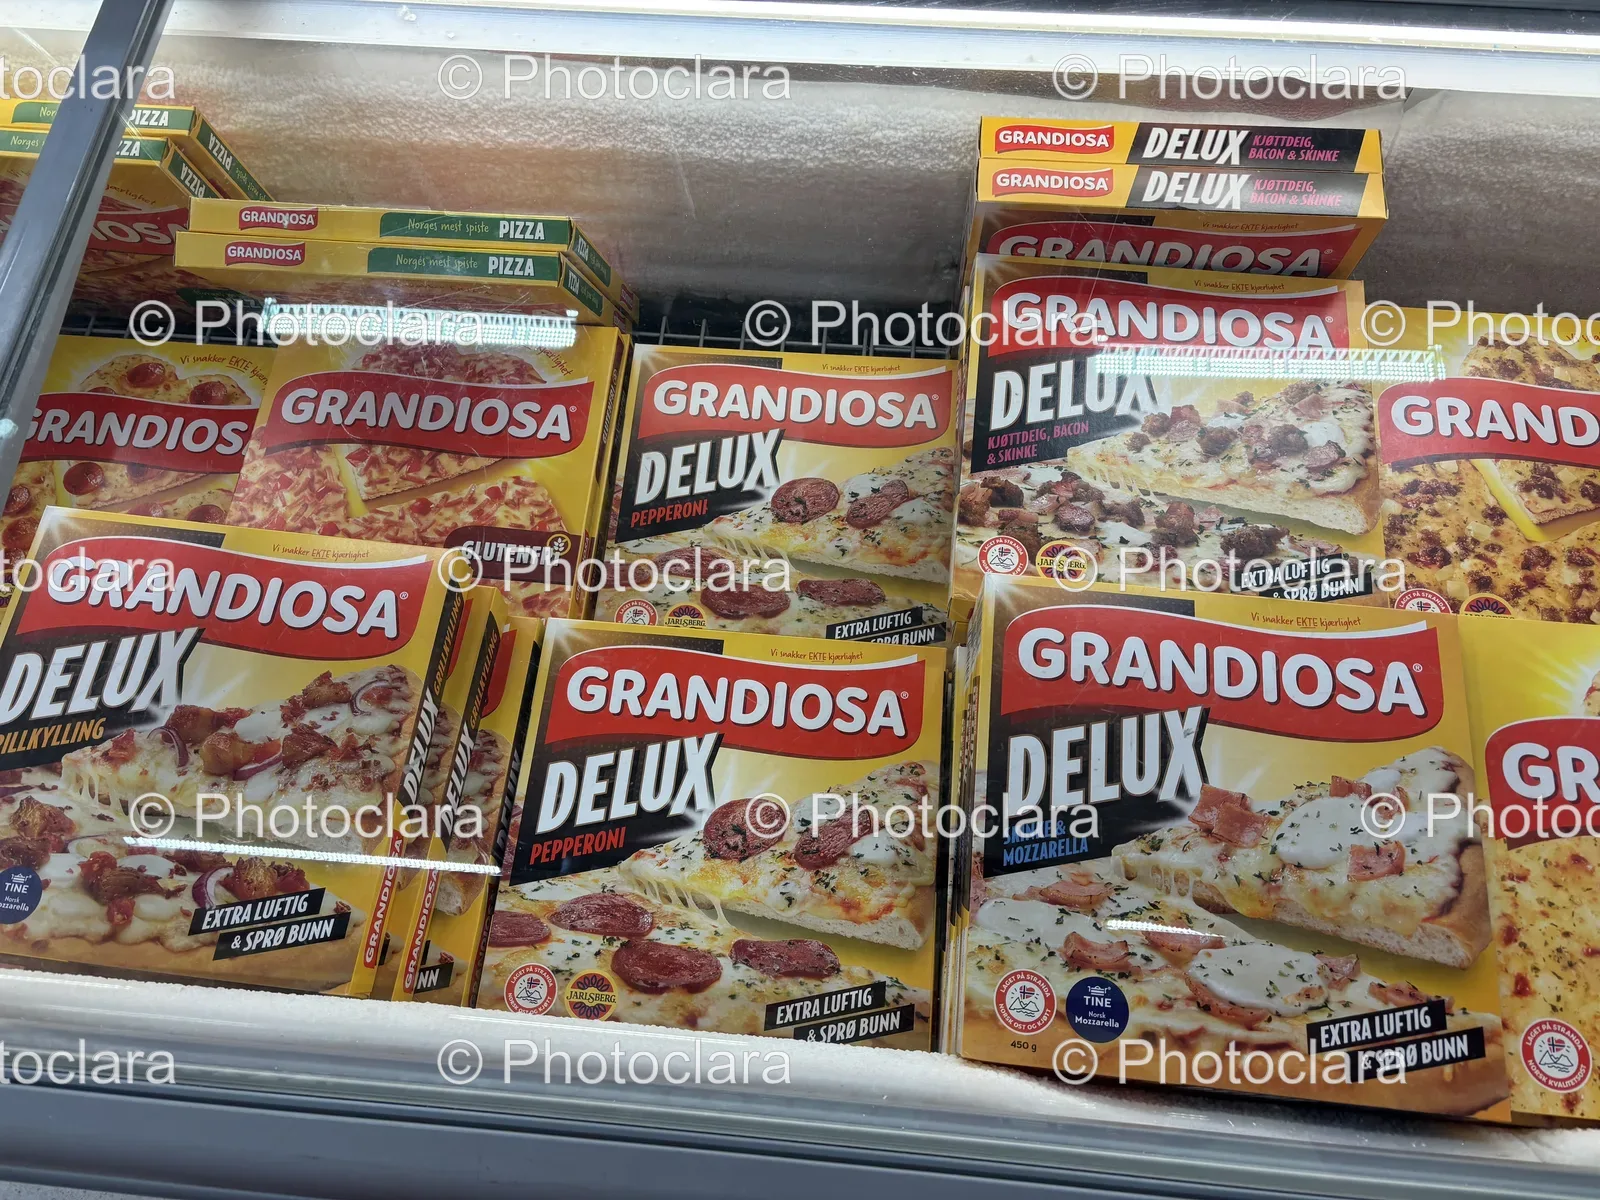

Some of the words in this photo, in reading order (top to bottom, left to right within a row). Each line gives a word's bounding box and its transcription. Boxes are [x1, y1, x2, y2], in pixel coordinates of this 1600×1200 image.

[10, 135, 39, 150] Norges
[208, 132, 233, 171] PIZZA
[998, 129, 1110, 148] GRANDIOSA
[1142, 127, 1250, 166] DELUX
[1252, 135, 1315, 149] KJØTTDEIG,
[1248, 148, 1286, 160] BACON
[1287, 150, 1297, 160] &
[1299, 149, 1340, 162] SKINKE
[996, 172, 1108, 192] GRANDIOSA
[1141, 170, 1251, 209] DELUX
[1254, 179, 1317, 194] KJØTTDEIG,
[1250, 192, 1288, 205] BACON
[1288, 194, 1298, 205] &
[1300, 193, 1343, 207] SKINKE
[241, 210, 316, 226] GRANDIOSA
[408, 218, 438, 232] Norges
[440, 219, 462, 231] mest
[466, 221, 489, 236] spiste
[499, 220, 545, 241] PIZZA
[1240, 222, 1260, 231] EKTE
[227, 246, 302, 261] GRANDIOSA
[395, 254, 426, 268] Norges
[429, 256, 451, 268] mest
[454, 259, 478, 271] spiste
[488, 256, 535, 278] PIZZA
[998, 235, 1322, 277] GRANDIOSA
[1193, 279, 1202, 288] Vi
[1202, 281, 1230, 290] snakker
[1231, 282, 1250, 292] EKTE
[1250, 282, 1285, 293] kjærlighet
[1003, 291, 1335, 350] GRANDIOSA
[180, 355, 190, 365] Vi
[192, 353, 226, 364] snakker
[228, 355, 253, 372] EKTE
[854, 365, 870, 374] EKTE
[280, 387, 571, 443] GRANDIOSA
[653, 380, 938, 430] GRANDIOSA
[988, 427, 1051, 450] KJØTTDEIG,
[1053, 421, 1089, 439] BACON
[634, 428, 781, 507] DELUX
[987, 452, 997, 465] &
[998, 444, 1038, 463] SKINKE
[631, 499, 709, 528] PEPPERONI
[272, 544, 281, 553] Vi
[282, 545, 310, 557] snakker
[311, 548, 331, 559] EKTE
[331, 549, 370, 561] kjærlighet
[1241, 567, 1281, 589] EXTRA
[1285, 558, 1331, 580] LUFTIG
[47, 556, 399, 639] GRANDIOSA
[1321, 578, 1360, 600] BUNN
[1399, 594, 1413, 608] LAGET
[1421, 592, 1445, 611] STRANDA
[664, 617, 706, 627] JARLSBERG
[835, 620, 870, 639] EXTRA
[873, 611, 912, 632] LUFTIG
[902, 627, 936, 645] BUNN
[1251, 612, 1261, 622] Vi
[1261, 613, 1294, 626] snakker
[1295, 615, 1318, 627] EKTE
[1319, 615, 1362, 631] kjærlighet
[433, 592, 462, 697] GRILLKYLLING
[770, 648, 778, 658] Vi
[779, 649, 807, 660] snakker
[808, 651, 827, 661] EKTE
[828, 651, 864, 663] kjærlighet
[0, 627, 200, 725] DELUX
[469, 629, 498, 730] GRILLKYLLING
[1018, 627, 1426, 717] GRANDIOSA
[566, 665, 907, 737] GRANDIOSA
[402, 687, 440, 804] DELUX
[441, 721, 476, 832] DELUX
[1004, 705, 1204, 820] DELUX
[535, 732, 719, 835] DELUX
[1056, 820, 1066, 836] &
[529, 825, 626, 866] PEPPERONI
[1003, 837, 1089, 867] MOZZARELLA
[4, 896, 20, 904] Norsk
[5, 882, 30, 895] TINE
[202, 904, 252, 931] EXTRA
[253, 893, 310, 921] LUFTIG
[231, 934, 241, 949] &
[242, 925, 286, 952] SPRØ
[287, 918, 335, 945] BUNN
[405, 868, 440, 990] GRANDIOSA
[511, 970, 526, 984] LAGET
[526, 965, 534, 973] PÅ
[534, 967, 554, 988] STRANDA
[1000, 976, 1016, 994] LAGET
[1017, 971, 1026, 980] PÅ
[1026, 973, 1051, 998] STRANDA
[508, 992, 519, 1009] NORSK
[566, 990, 617, 1004] JARLSBERG
[776, 999, 820, 1025] EXTRA
[824, 987, 873, 1015] LUFTIG
[1083, 995, 1112, 1008] TINE
[807, 1029, 816, 1042] &
[819, 1020, 857, 1043] SPRØ
[859, 1010, 901, 1037] BUNN
[999, 1003, 1014, 1025] NORSK
[1013, 1022, 1026, 1030] OST
[1037, 1008, 1052, 1027] KJØTT
[1075, 1015, 1120, 1028] Mozzarella
[1088, 1011, 1106, 1019] Norsk
[1320, 1017, 1373, 1048] EXTRA
[1375, 1006, 1432, 1038] LUFTIG
[1010, 1040, 1029, 1050] 450
[1031, 1042, 1037, 1053] g
[1422, 1034, 1469, 1065] BUNN
[1526, 1026, 1541, 1046] LAGET
[1542, 1022, 1552, 1031] PÅ
[1553, 1024, 1584, 1051] STRANDA
[1528, 1059, 1548, 1083] NORSK
[1548, 1064, 1587, 1088] KVALITETSOST
